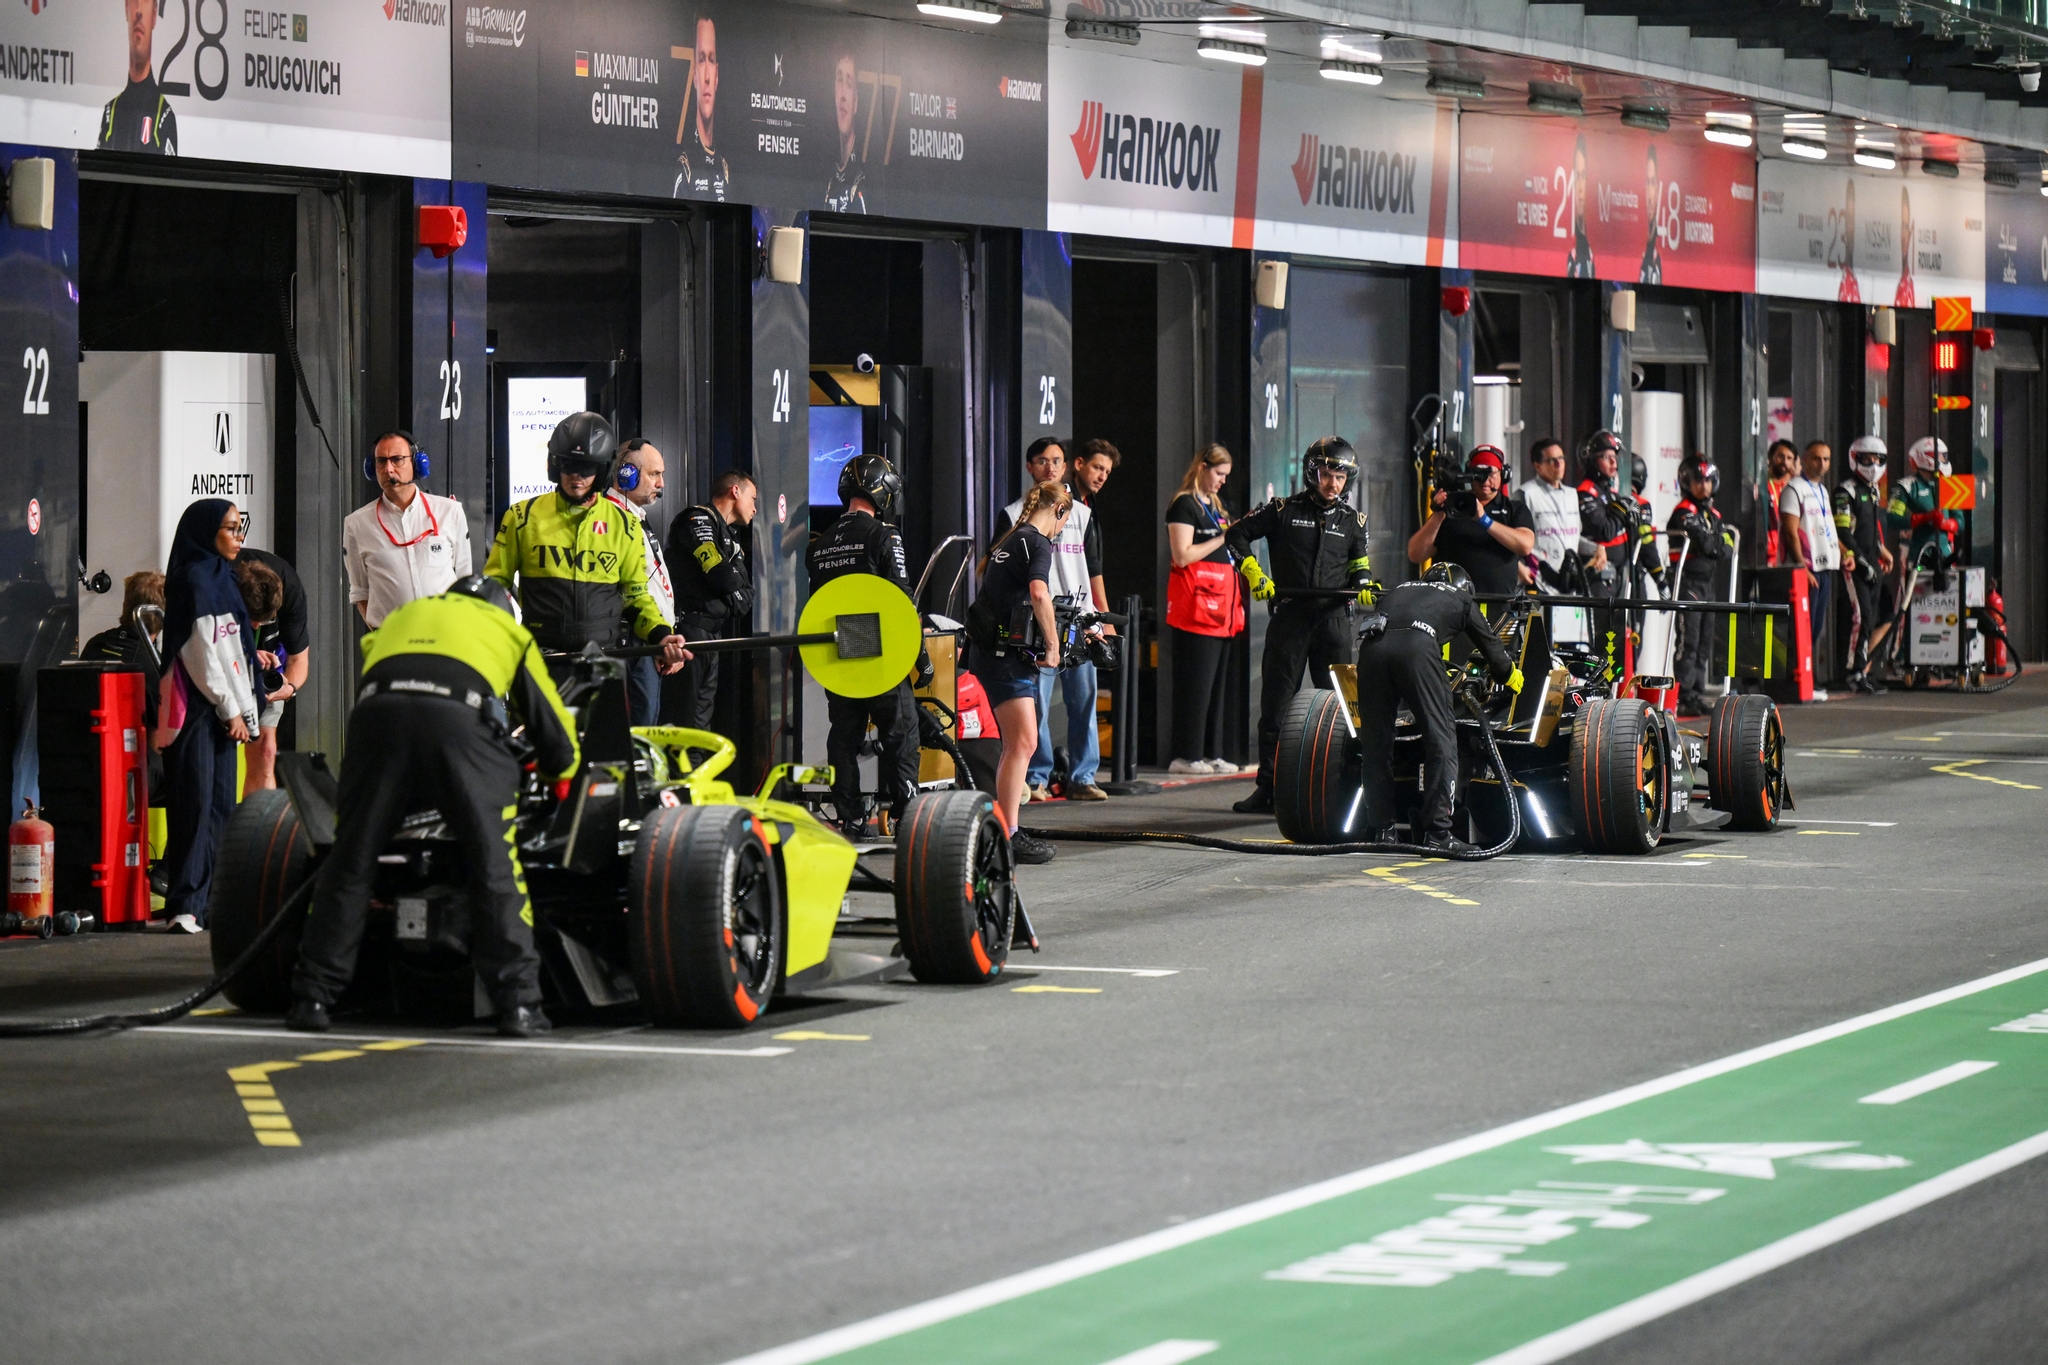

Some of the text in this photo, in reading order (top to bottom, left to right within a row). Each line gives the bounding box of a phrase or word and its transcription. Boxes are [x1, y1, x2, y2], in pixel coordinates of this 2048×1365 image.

[244, 9, 288, 41] FELIPE
[394, 0, 447, 27] Hankook
[466, 6, 481, 26] ABB
[480, 6, 516, 34] FORMULA
[0, 44, 74, 85] ANDRETTI
[159, 0, 229, 101] 28
[593, 52, 659, 84] MAXIMILIAN
[244, 53, 341, 96] DRUGOVICH
[670, 45, 695, 144] 7
[1007, 79, 1043, 102] Hankook
[592, 84, 659, 129] GÜNTHER
[751, 93, 806, 113] DS AUTOMOBILES
[857, 70, 901, 166] 77
[909, 92, 942, 118] TAYLOR
[758, 133, 800, 155] PENSKE
[909, 128, 964, 161] BARNARD
[1100, 112, 1221, 192] Hankook
[1316, 143, 1418, 215] Hankook
[1553, 166, 1575, 238] 21
[23, 347, 49, 415] 22
[440, 360, 462, 420] 23
[772, 369, 790, 423] 24
[1039, 375, 1056, 425] 25
[1265, 383, 1279, 429] 26
[1452, 390, 1465, 432] 27
[191, 474, 254, 495] ANDRETTI
[533, 544, 597, 574] TWG
[818, 558, 856, 570] PENSKE
[1914, 597, 1956, 608] NISSAN
[1690, 742, 1701, 764] DS
